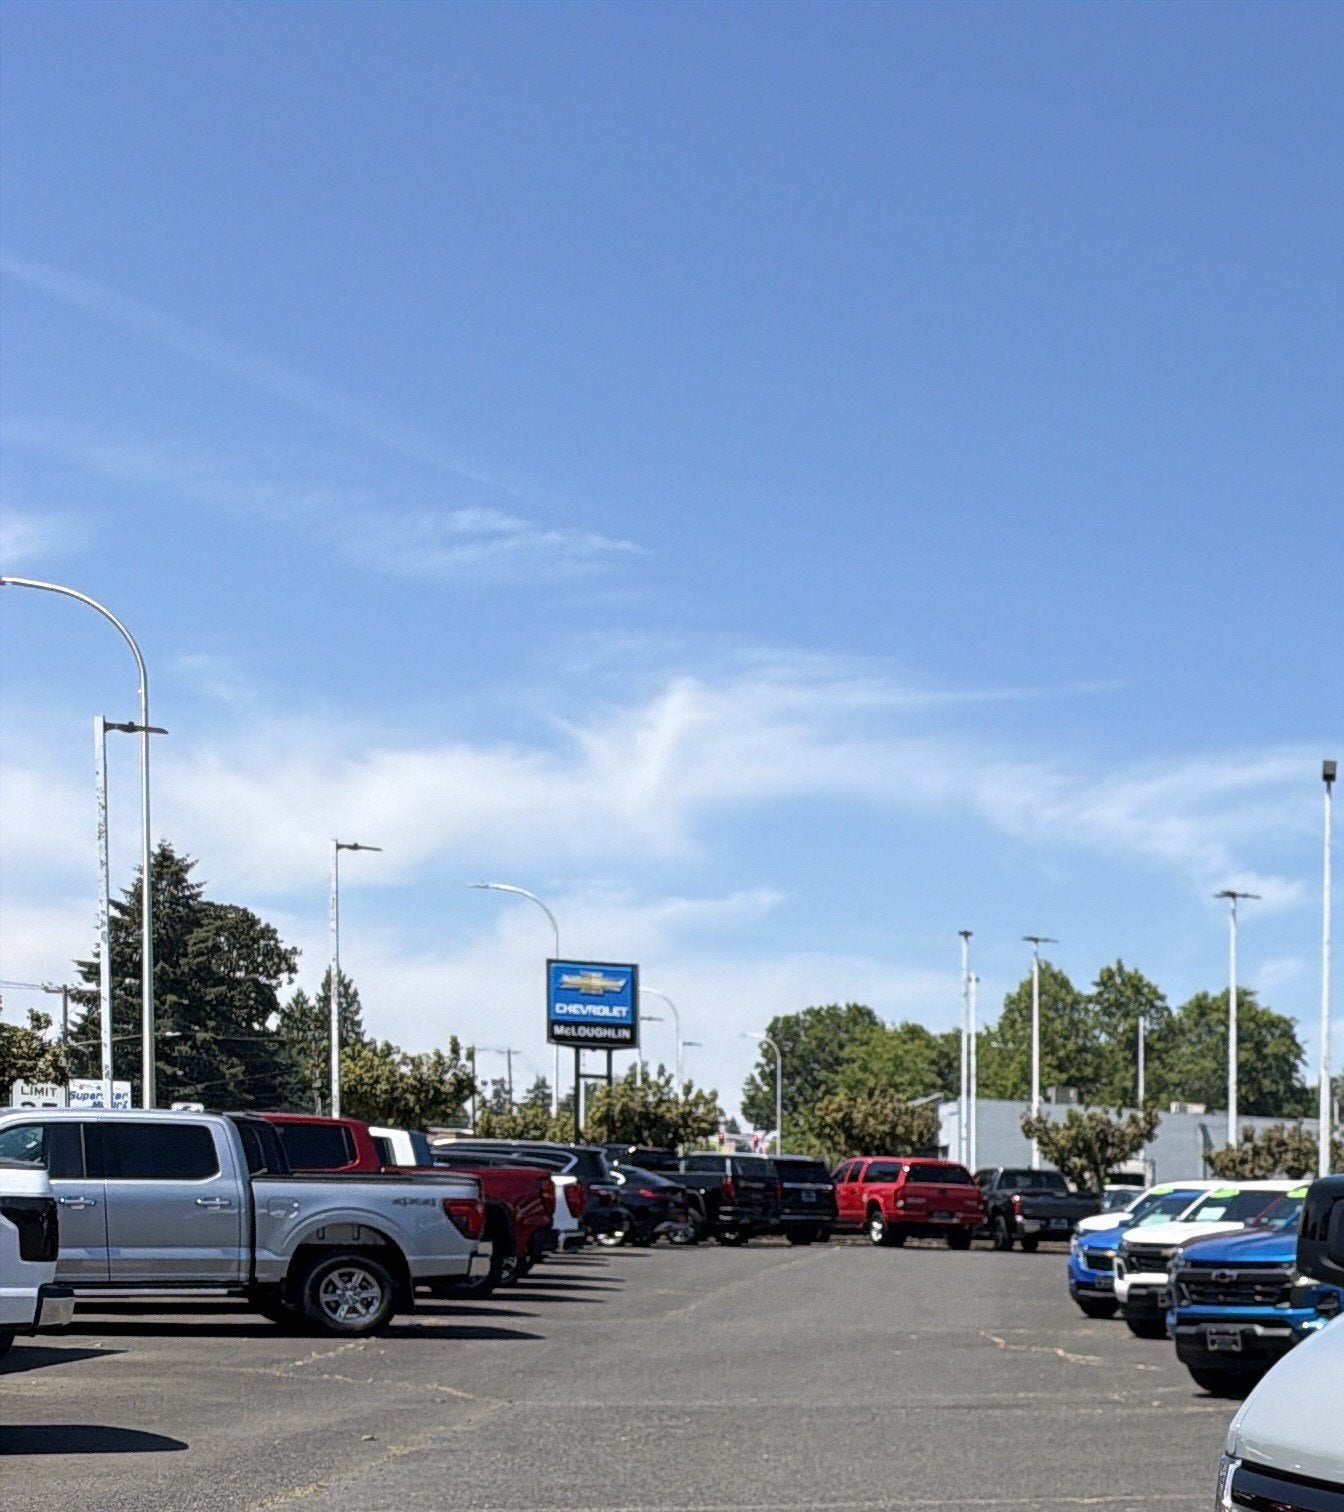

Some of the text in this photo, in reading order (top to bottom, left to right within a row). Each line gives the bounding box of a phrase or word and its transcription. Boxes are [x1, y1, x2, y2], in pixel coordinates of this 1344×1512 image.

[555, 1003, 629, 1017] CHEVROLET
[554, 1025, 631, 1039] McLOUGHLIN
[21, 1086, 57, 1097] LIMIT
